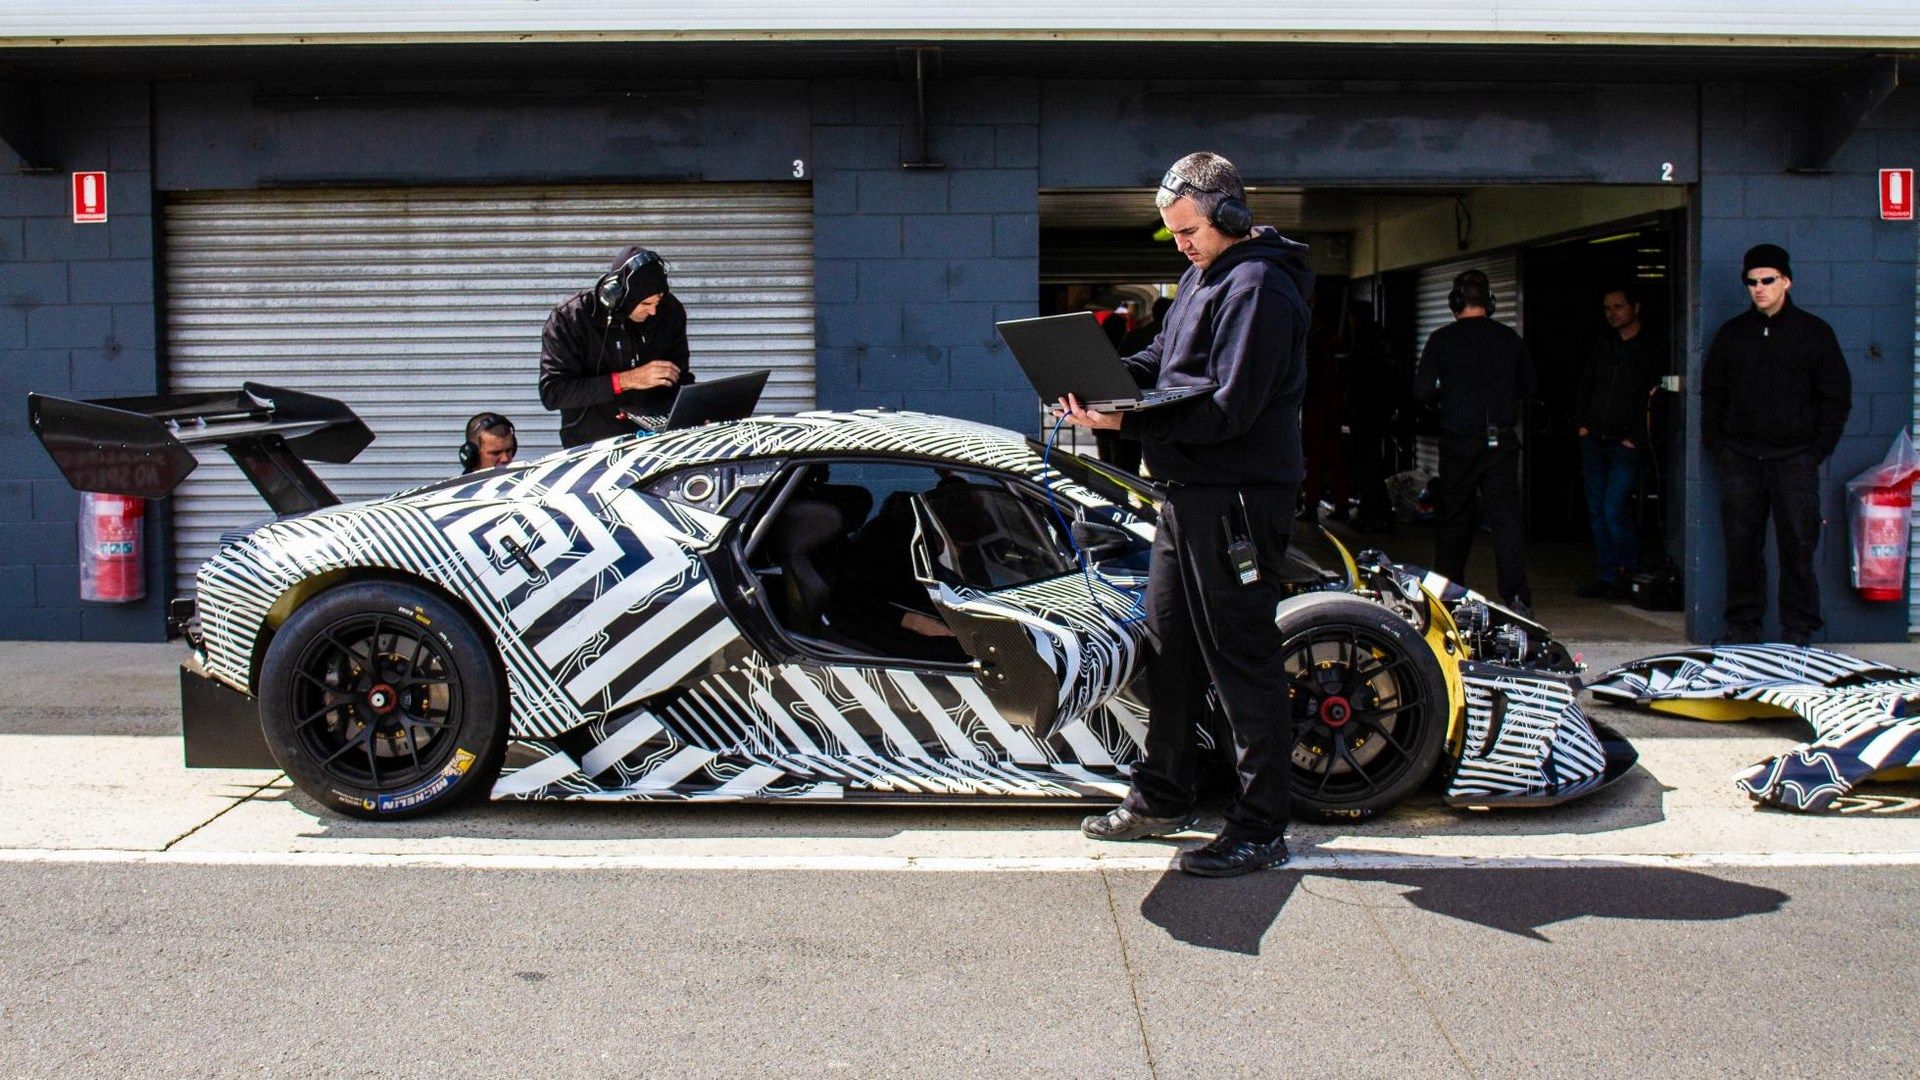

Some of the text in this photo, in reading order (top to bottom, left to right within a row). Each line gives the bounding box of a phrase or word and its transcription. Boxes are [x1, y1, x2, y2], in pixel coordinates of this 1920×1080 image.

[792, 159, 804, 178] 3
[1661, 161, 1673, 181] 2
[382, 777, 449, 810] MICHELIN
